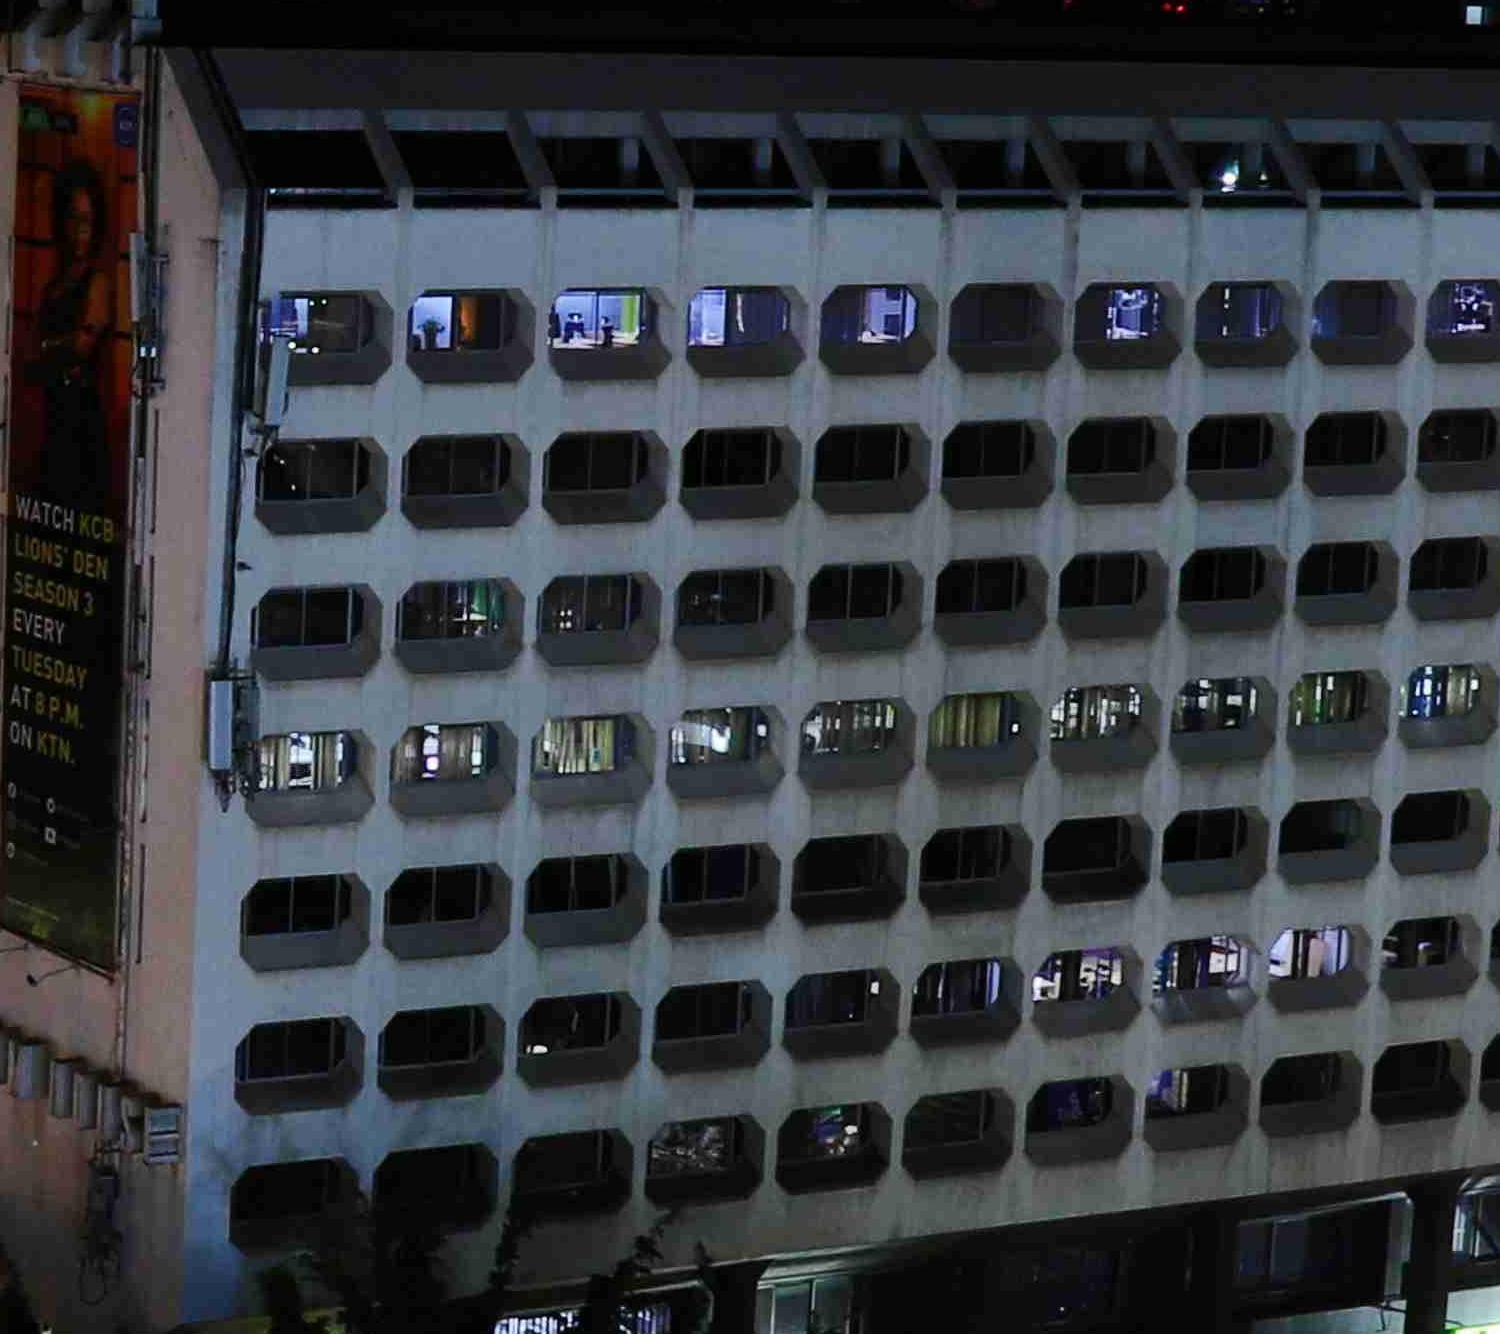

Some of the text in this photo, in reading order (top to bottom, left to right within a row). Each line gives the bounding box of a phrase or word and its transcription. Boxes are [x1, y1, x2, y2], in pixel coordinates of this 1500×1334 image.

[16, 493, 116, 543] WATCH KCB
[73, 550, 111, 581] DEN
[12, 570, 96, 617] SEASON 3
[12, 608, 66, 648] EVERY
[11, 644, 89, 691] TUESDAY
[11, 684, 32, 712] AT
[34, 692, 46, 716] 8
[10, 720, 81, 771] ON KTN.
